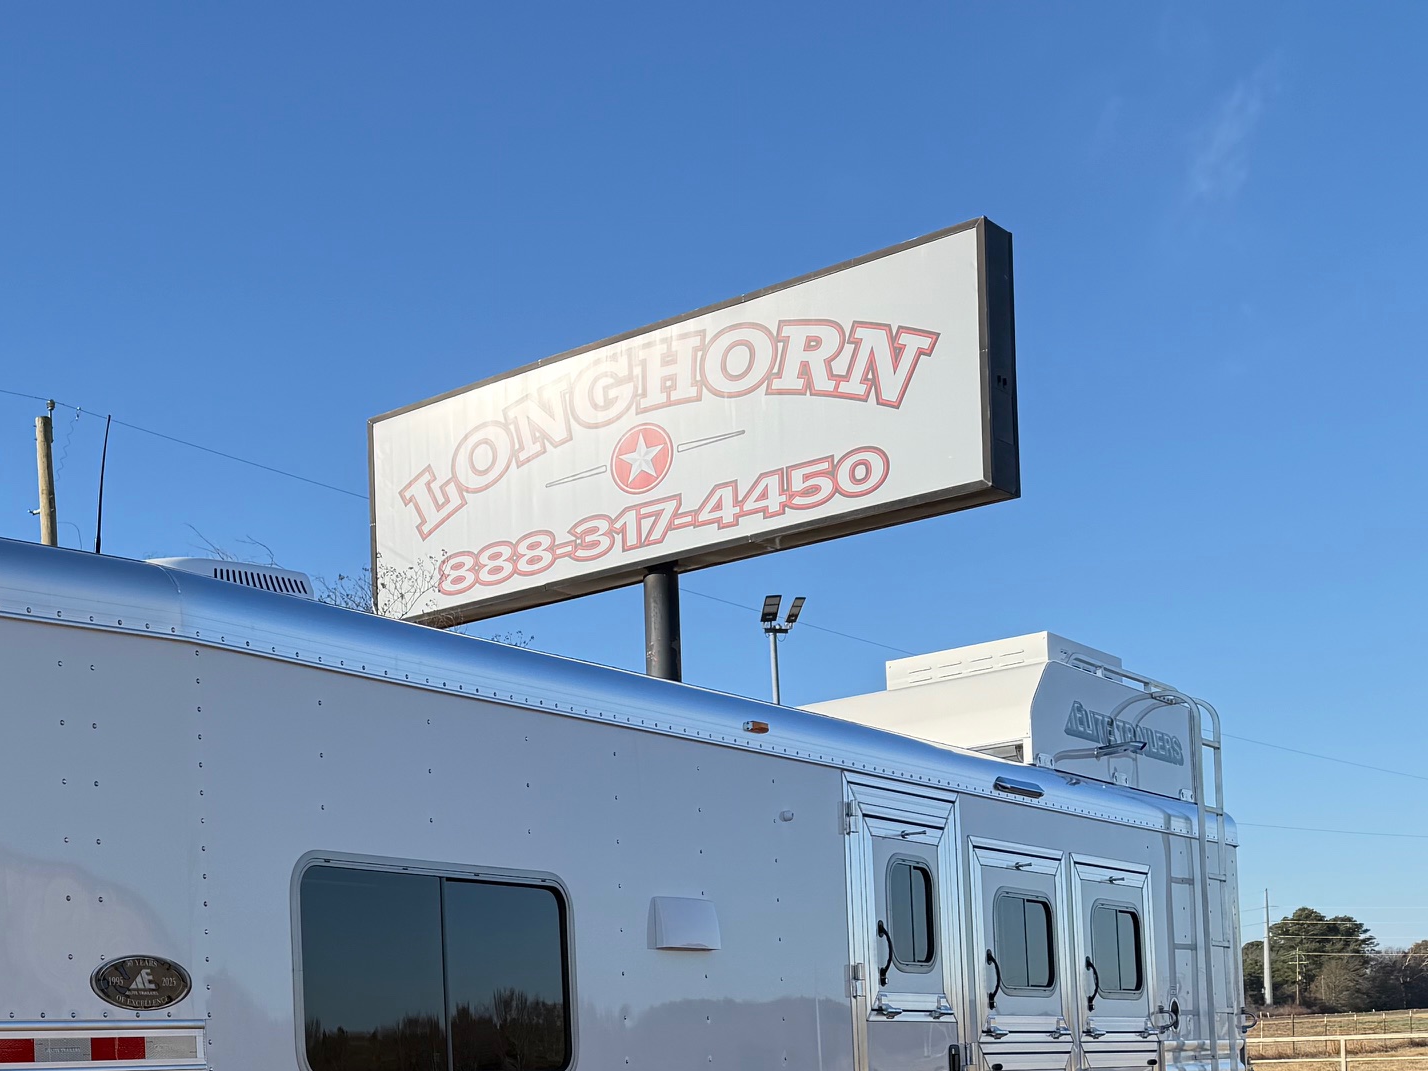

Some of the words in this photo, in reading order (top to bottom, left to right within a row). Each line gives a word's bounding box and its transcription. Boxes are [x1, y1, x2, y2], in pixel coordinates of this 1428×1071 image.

[398, 318, 941, 540] LONGHORN
[438, 445, 890, 596] 888-317-4450
[134, 959, 158, 967] YEARS
[108, 976, 124, 987] 1995
[162, 977, 177, 987] 2025
[116, 994, 126, 1003] OF
